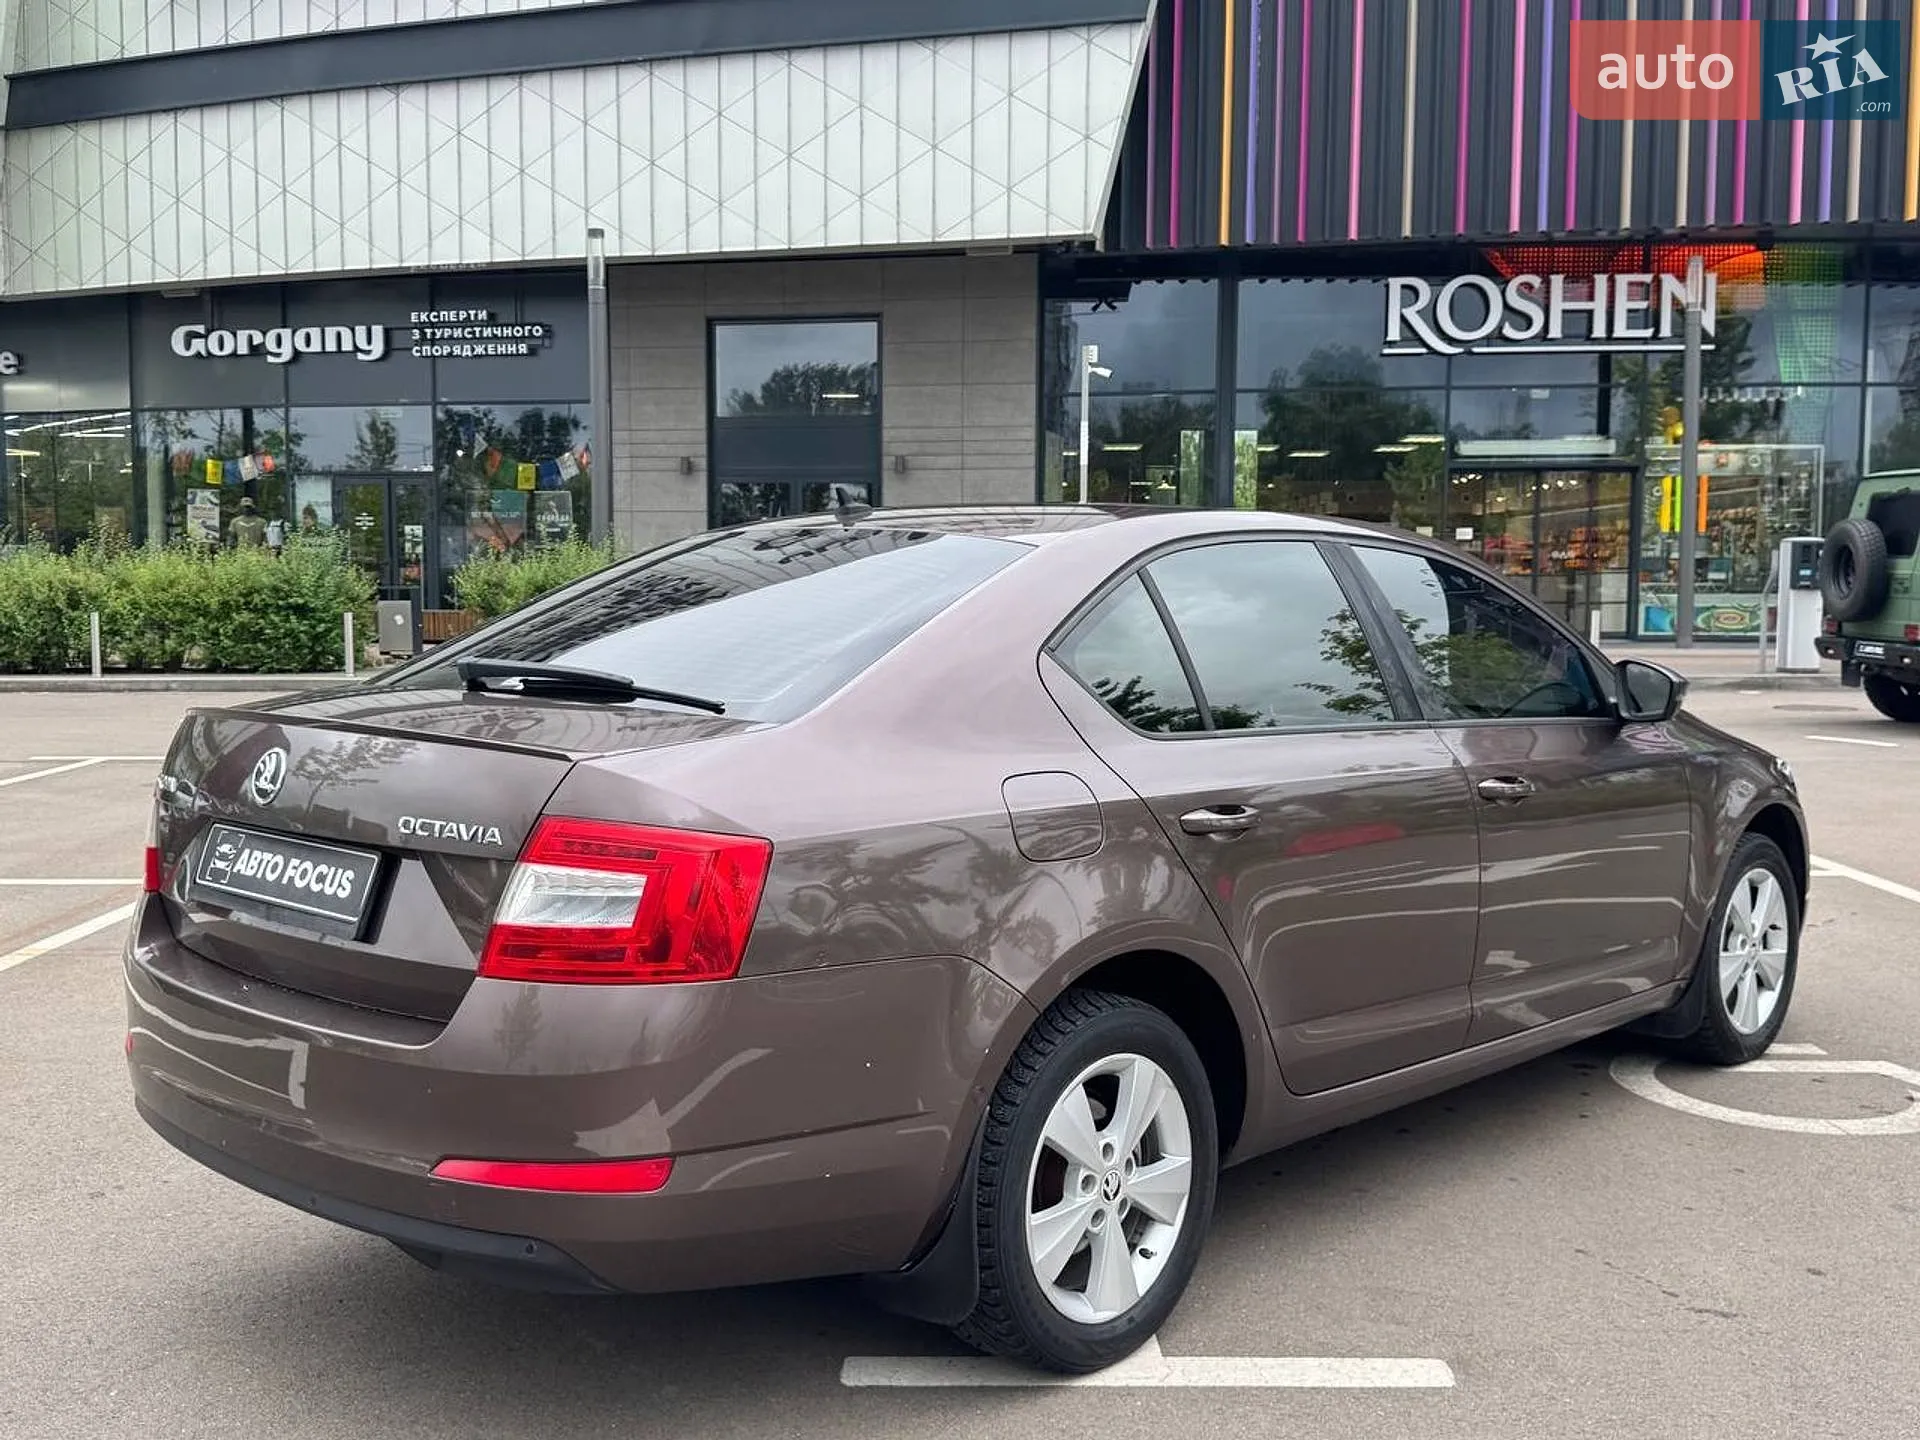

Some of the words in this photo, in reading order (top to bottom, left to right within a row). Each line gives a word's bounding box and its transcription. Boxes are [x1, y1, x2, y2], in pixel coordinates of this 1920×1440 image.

[411, 309, 488, 322] ЕКСПЕРТИ
[1384, 272, 1718, 355] ROSHEN
[171, 324, 384, 363] Gorgany
[424, 325, 543, 339] ТУРИСТИЧНОГО
[412, 343, 529, 357] СПОРЯДЖЕННЯ
[398, 816, 503, 846] OCTAVIA
[281, 857, 356, 899] FOCUS
